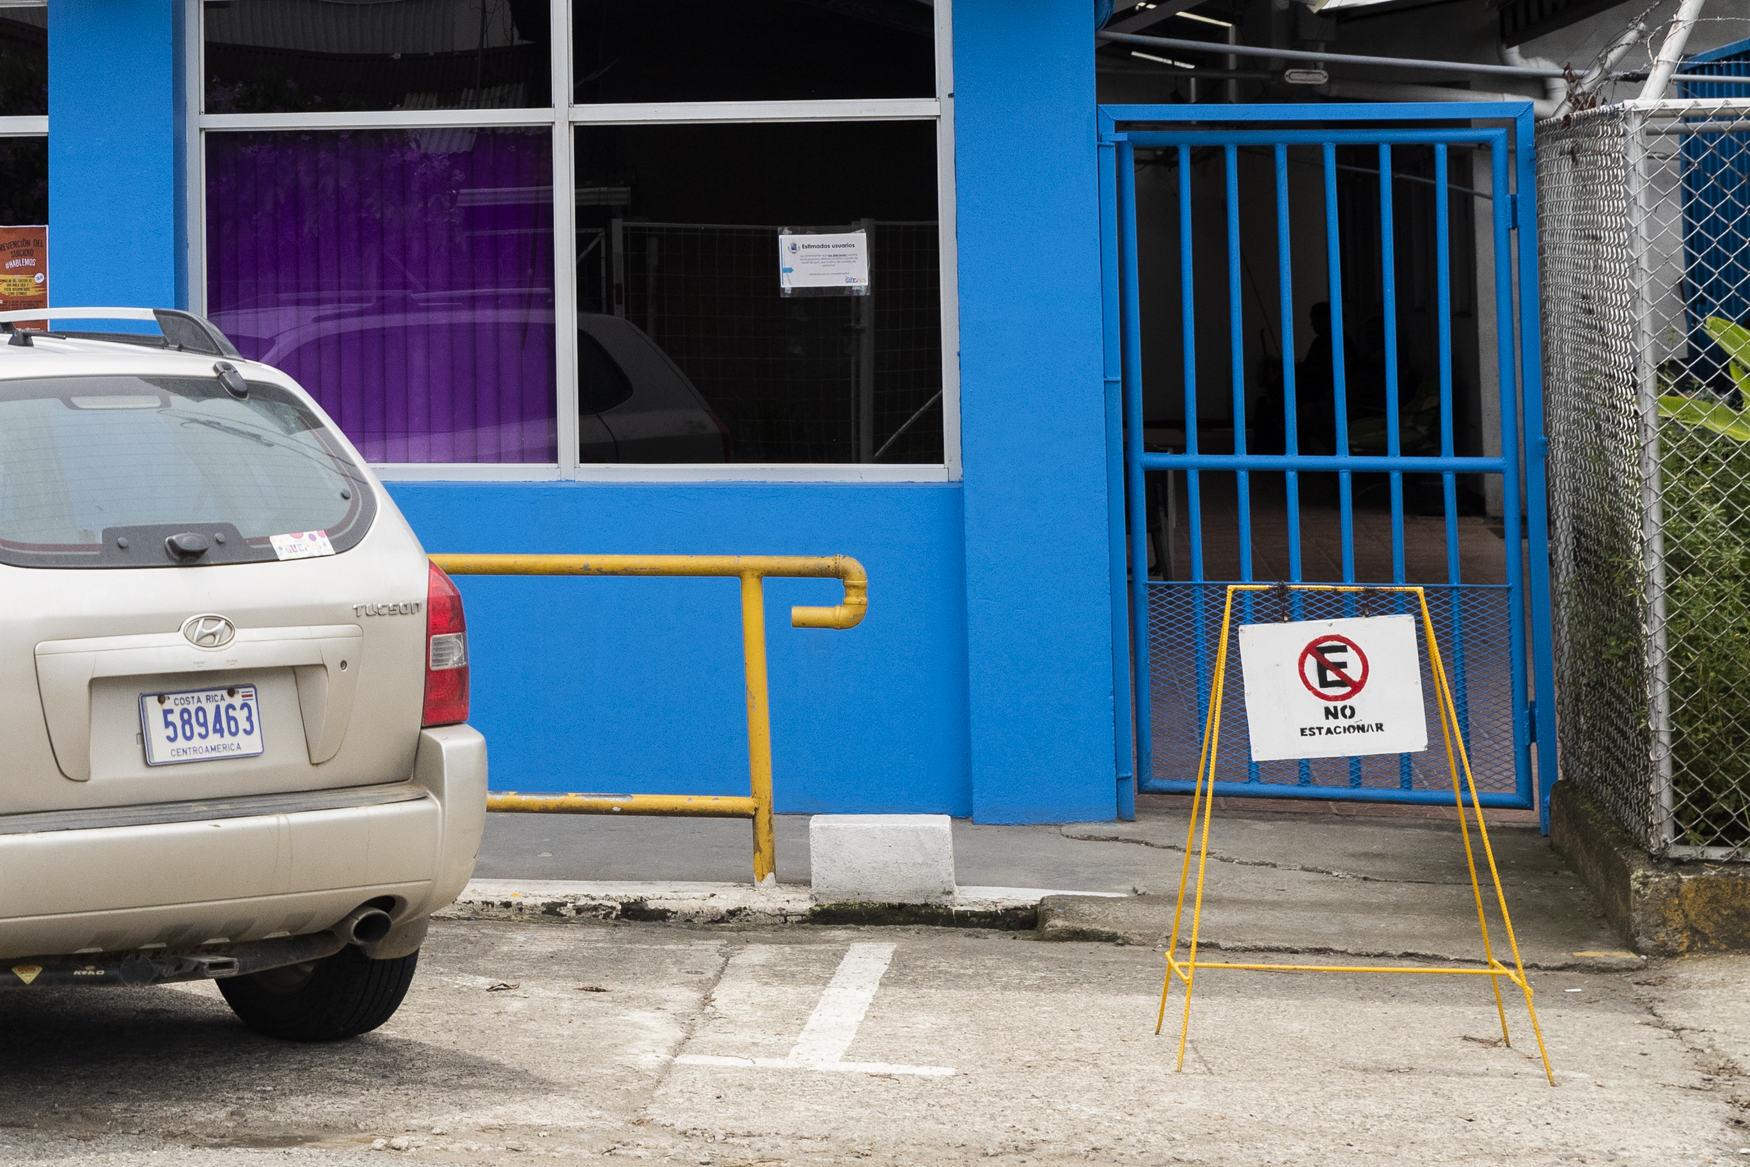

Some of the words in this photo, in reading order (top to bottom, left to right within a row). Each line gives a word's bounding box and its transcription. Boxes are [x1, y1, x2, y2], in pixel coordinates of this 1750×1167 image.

[33, 239, 44, 248] DEL
[10, 248, 34, 258] SUICIDIO
[4, 258, 36, 270] #HABLEMOS
[352, 601, 423, 617] TUCSON
[173, 695, 203, 706] COSTA
[205, 694, 226, 703] RICA
[1323, 704, 1356, 720] NO
[162, 702, 255, 743] 589463
[1300, 722, 1385, 737] ESTACIONAR
[170, 742, 242, 757] CENTROAMERICA
